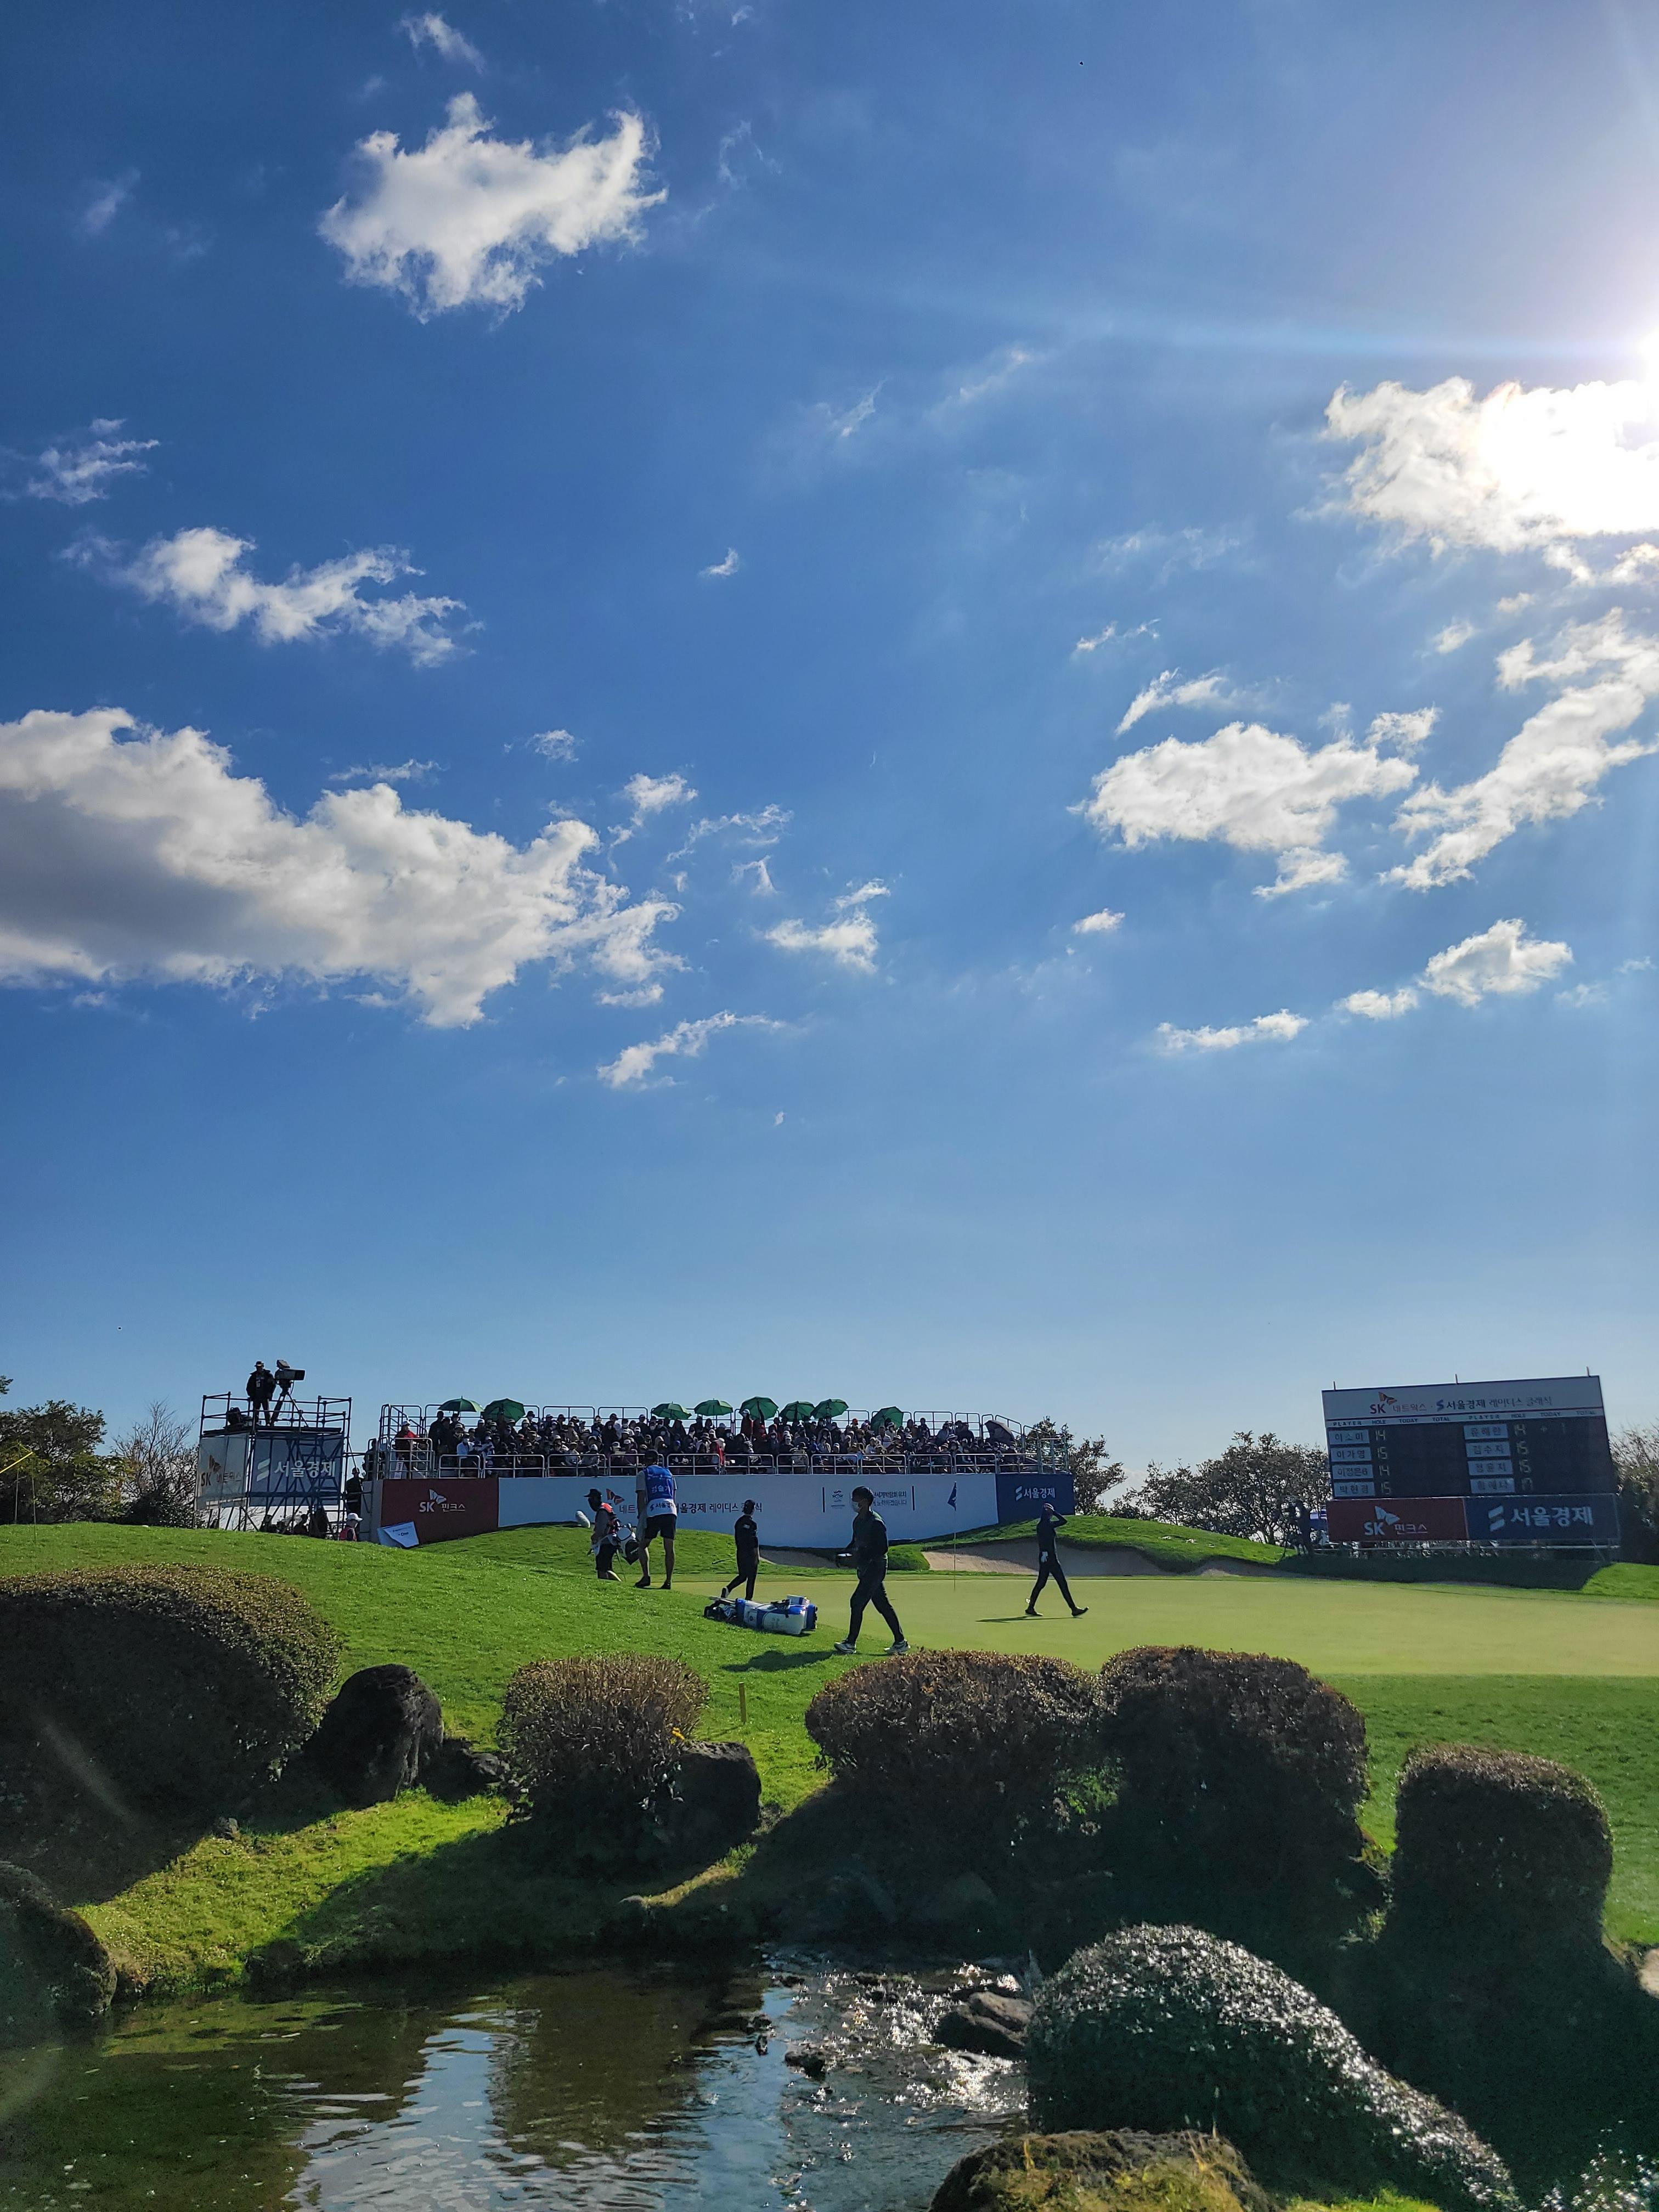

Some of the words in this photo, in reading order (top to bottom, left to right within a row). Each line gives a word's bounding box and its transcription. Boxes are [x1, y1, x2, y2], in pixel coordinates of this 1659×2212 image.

[1370, 1404, 1386, 1414] SK
[1447, 1399, 1486, 1410] 서울경제
[1375, 1430, 1386, 1441] 14
[1377, 1447, 1388, 1459] 15
[274, 1460, 336, 1479] 서울경제
[1379, 1465, 1390, 1476] 14
[200, 1472, 212, 1487] SK
[1024, 1487, 1056, 1499] 서울경제
[1381, 1481, 1392, 1495] 15
[419, 1502, 435, 1513] SK
[442, 1503, 466, 1512] 핀크스
[676, 1503, 706, 1514] 울경제
[709, 1503, 740, 1514] 레이디스
[1510, 1506, 1594, 1528] 서울경제
[1363, 1521, 1385, 1536] SK
[1394, 1523, 1428, 1534] 핀크스
